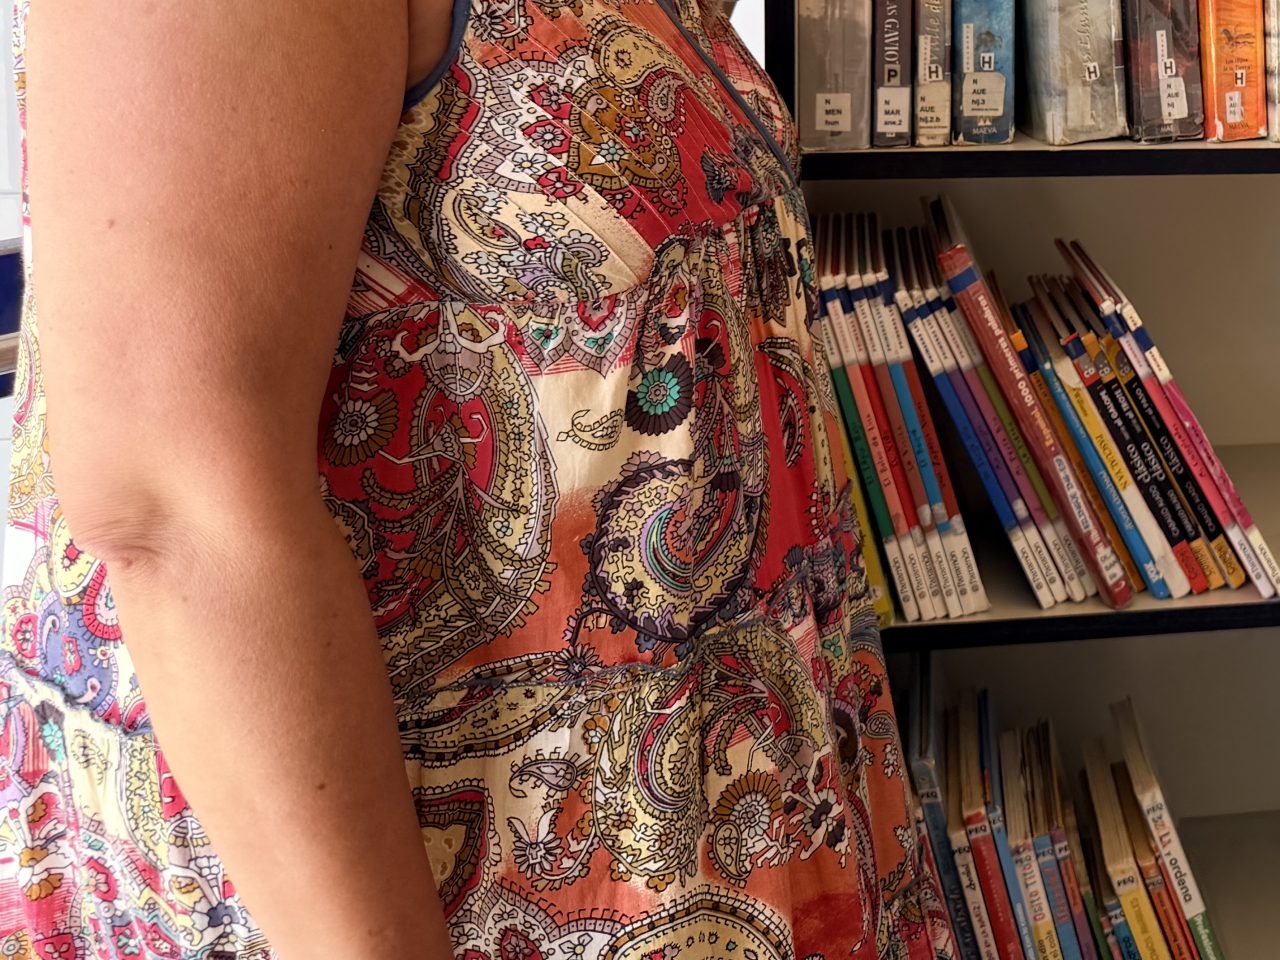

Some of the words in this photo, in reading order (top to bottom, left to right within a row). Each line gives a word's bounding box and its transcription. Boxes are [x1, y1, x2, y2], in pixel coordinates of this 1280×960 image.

[928, 66, 939, 78] H
[982, 56, 992, 69] H
[1088, 67, 1098, 79] H
[1164, 61, 1173, 74] H
[888, 70, 897, 82] P
[1235, 72, 1243, 84] H
[973, 293, 1004, 337] palabras
[994, 335, 1025, 380] primeras
[1016, 379, 1037, 407] 1000
[1099, 388, 1119, 419] GALOPE
[1113, 387, 1130, 411] TROTE
[1135, 386, 1149, 407] PASO
[1122, 442, 1152, 485] clásico
[1136, 440, 1166, 483] clásico
[1156, 433, 1185, 476] clásico
[1149, 483, 1165, 507] ALADO
[1167, 488, 1182, 510] ALADO
[1160, 505, 1180, 537] CABALLO
[1177, 508, 1195, 536] CABALLO
[1196, 502, 1216, 533] CABALLO
[1146, 803, 1164, 814] PEQ
[969, 825, 986, 834] PEQ
[1015, 856, 1031, 864] PEQ
[1019, 862, 1037, 889] Tito
[1117, 876, 1135, 886] PEQ
[1169, 857, 1192, 903] ordena
[1026, 889, 1045, 922] Osito
